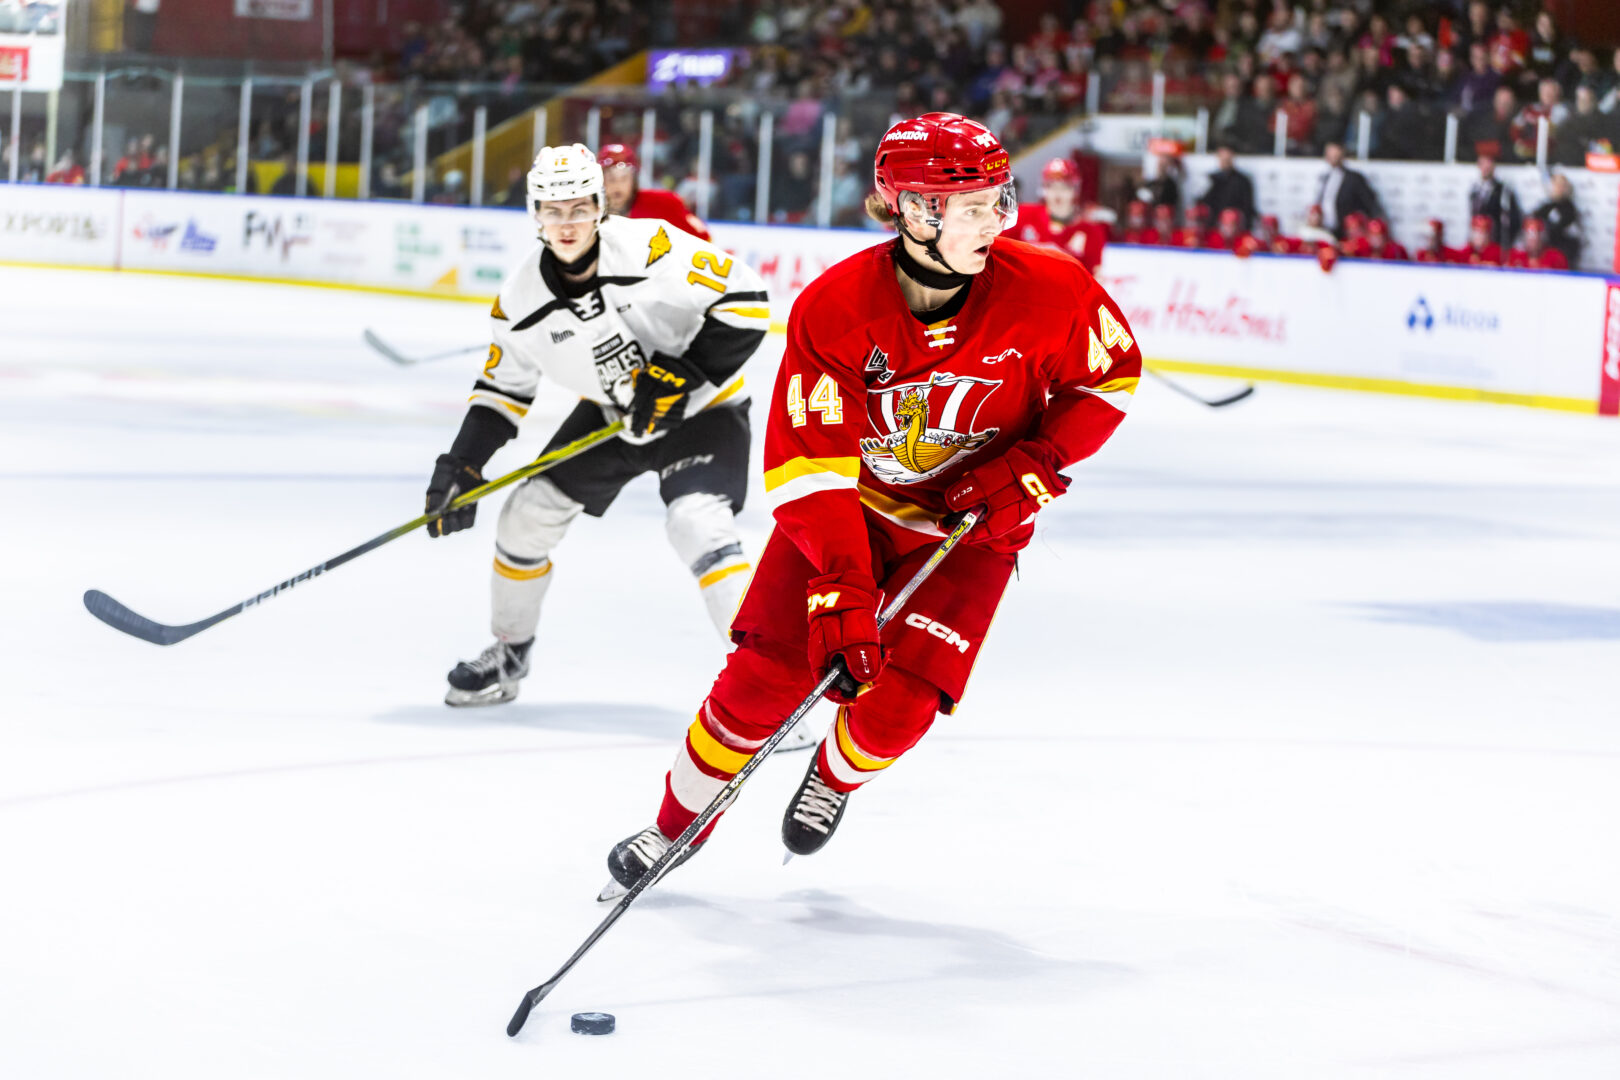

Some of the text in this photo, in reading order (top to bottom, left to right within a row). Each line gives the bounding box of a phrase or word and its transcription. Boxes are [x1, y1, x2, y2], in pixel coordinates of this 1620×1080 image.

[985, 158, 1008, 171] CCM
[686, 250, 734, 295] 12
[1087, 303, 1134, 375] 44
[786, 371, 844, 428] 44
[660, 453, 714, 481] CCM
[905, 612, 971, 654] CCM
